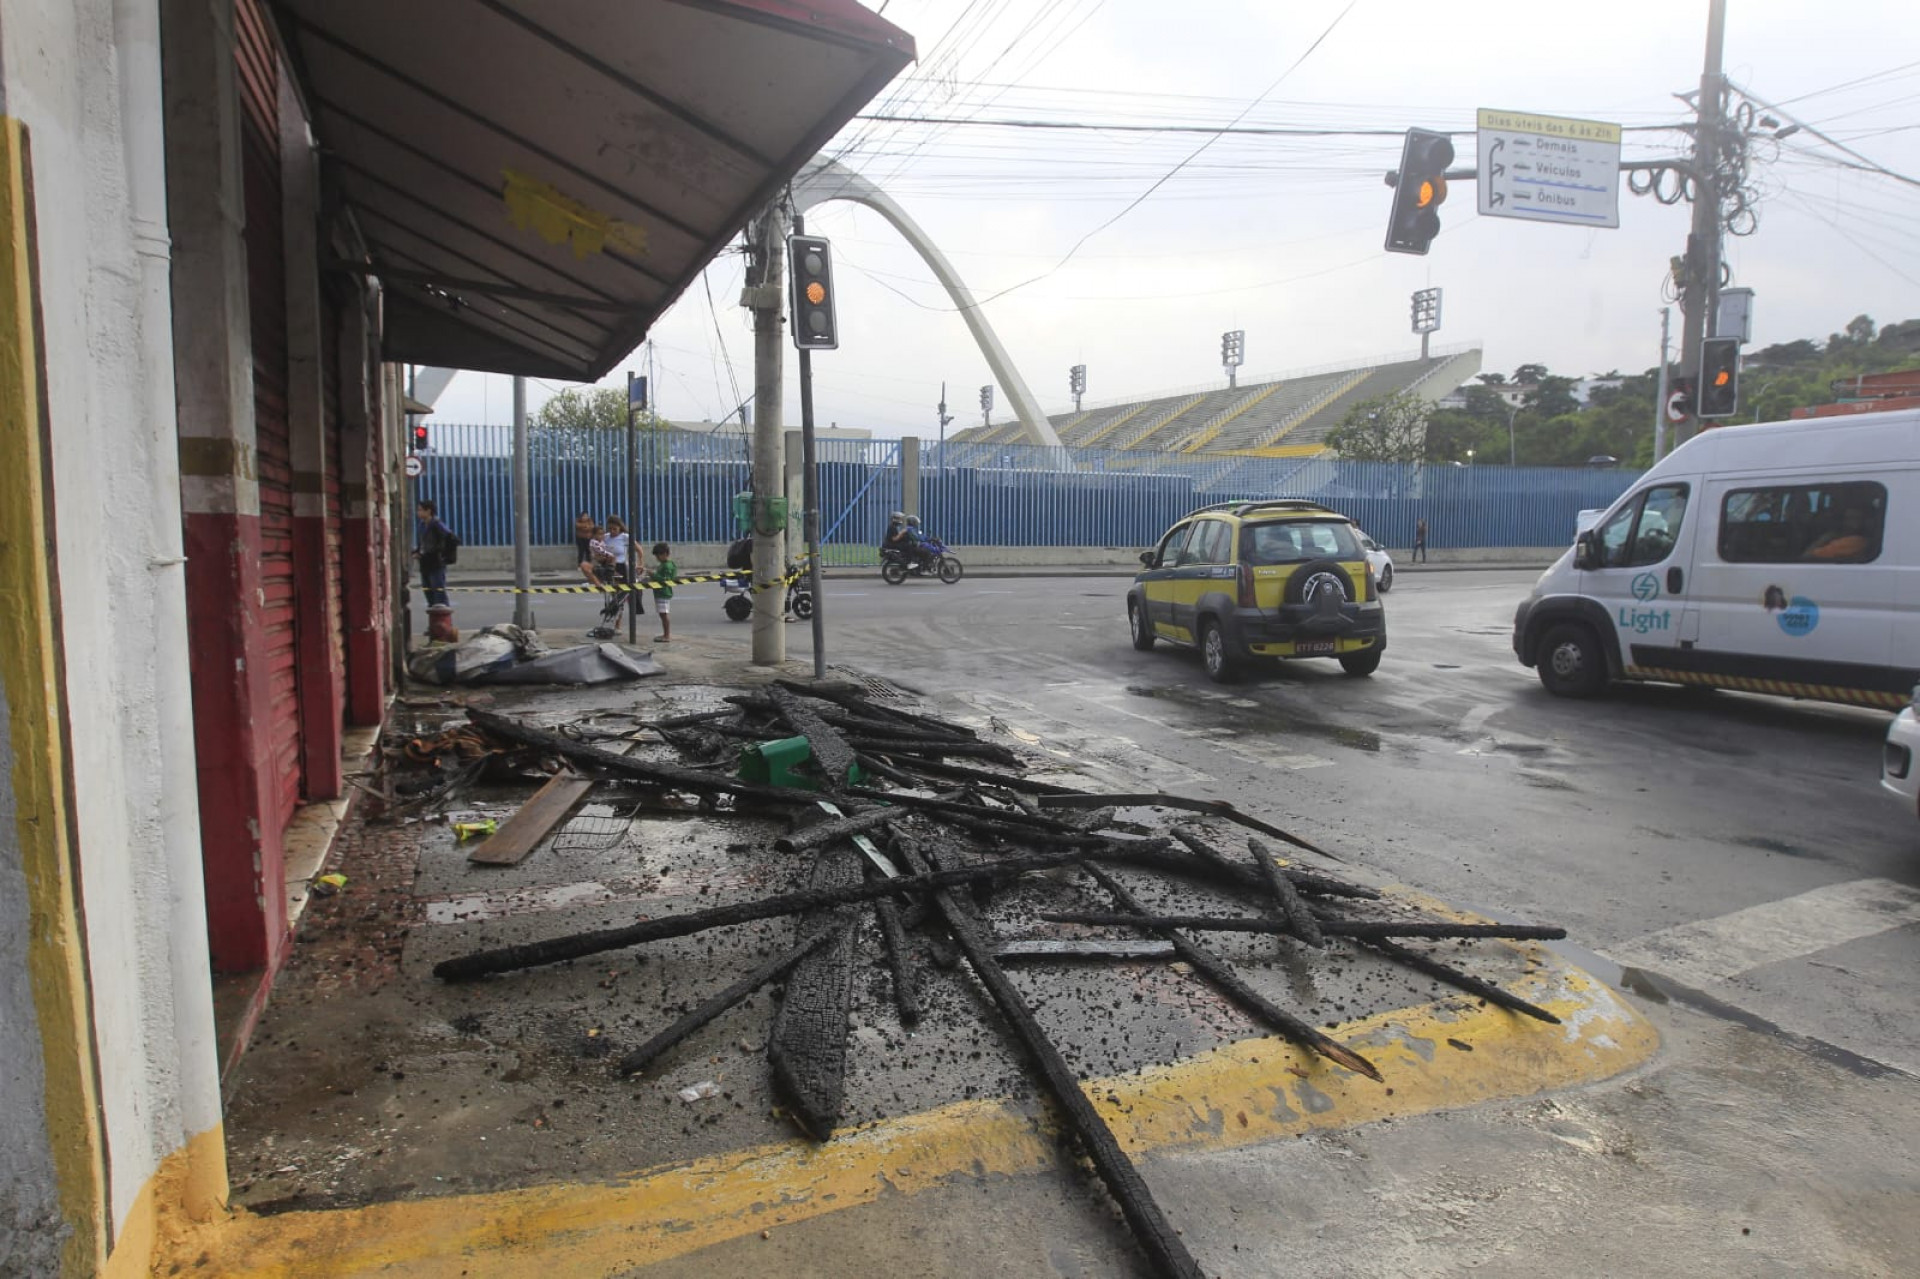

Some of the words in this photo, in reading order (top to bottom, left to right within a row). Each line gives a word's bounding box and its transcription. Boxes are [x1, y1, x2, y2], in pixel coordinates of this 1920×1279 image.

[1536, 138, 1577, 153] Demais
[1537, 187, 1576, 206] Ônibus
[1619, 607, 1671, 634] Light
